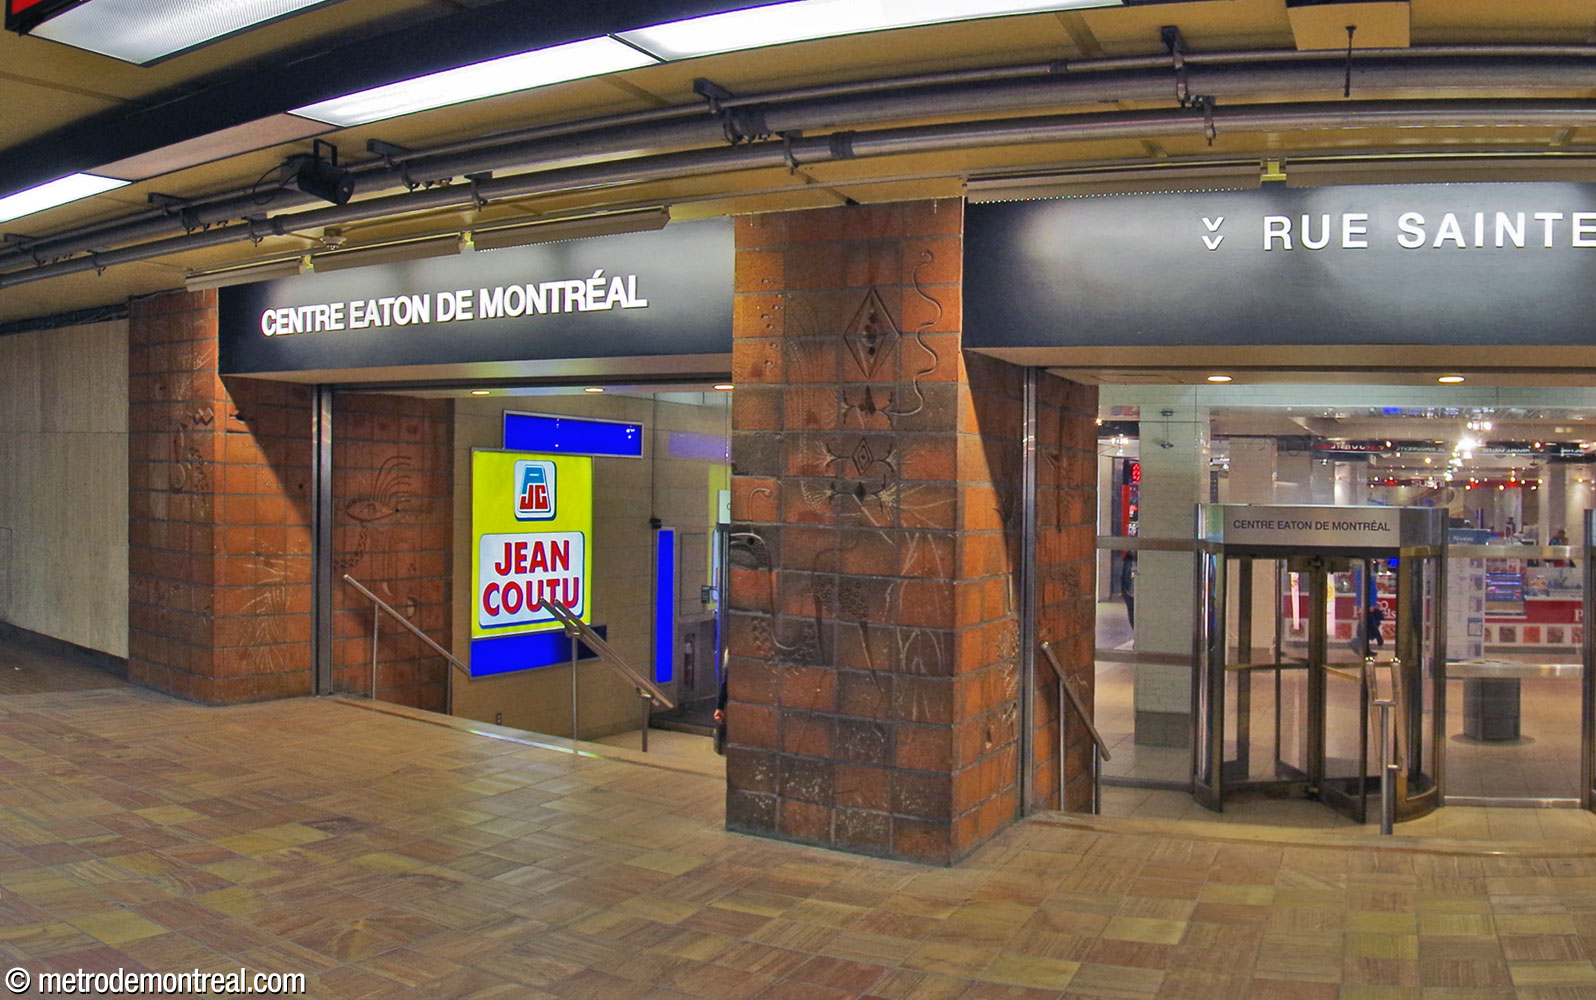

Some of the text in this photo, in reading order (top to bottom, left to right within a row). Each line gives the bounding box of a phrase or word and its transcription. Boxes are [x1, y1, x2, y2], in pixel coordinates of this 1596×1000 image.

[1263, 212, 1369, 250] RUE
[260, 269, 648, 337] CENTRE EATON DE MONTRÉAL
[1232, 518, 1391, 532] CENTRE EATON DE MONTRÉAL
[494, 539, 570, 577] JEAN
[482, 576, 580, 617] COUTU
